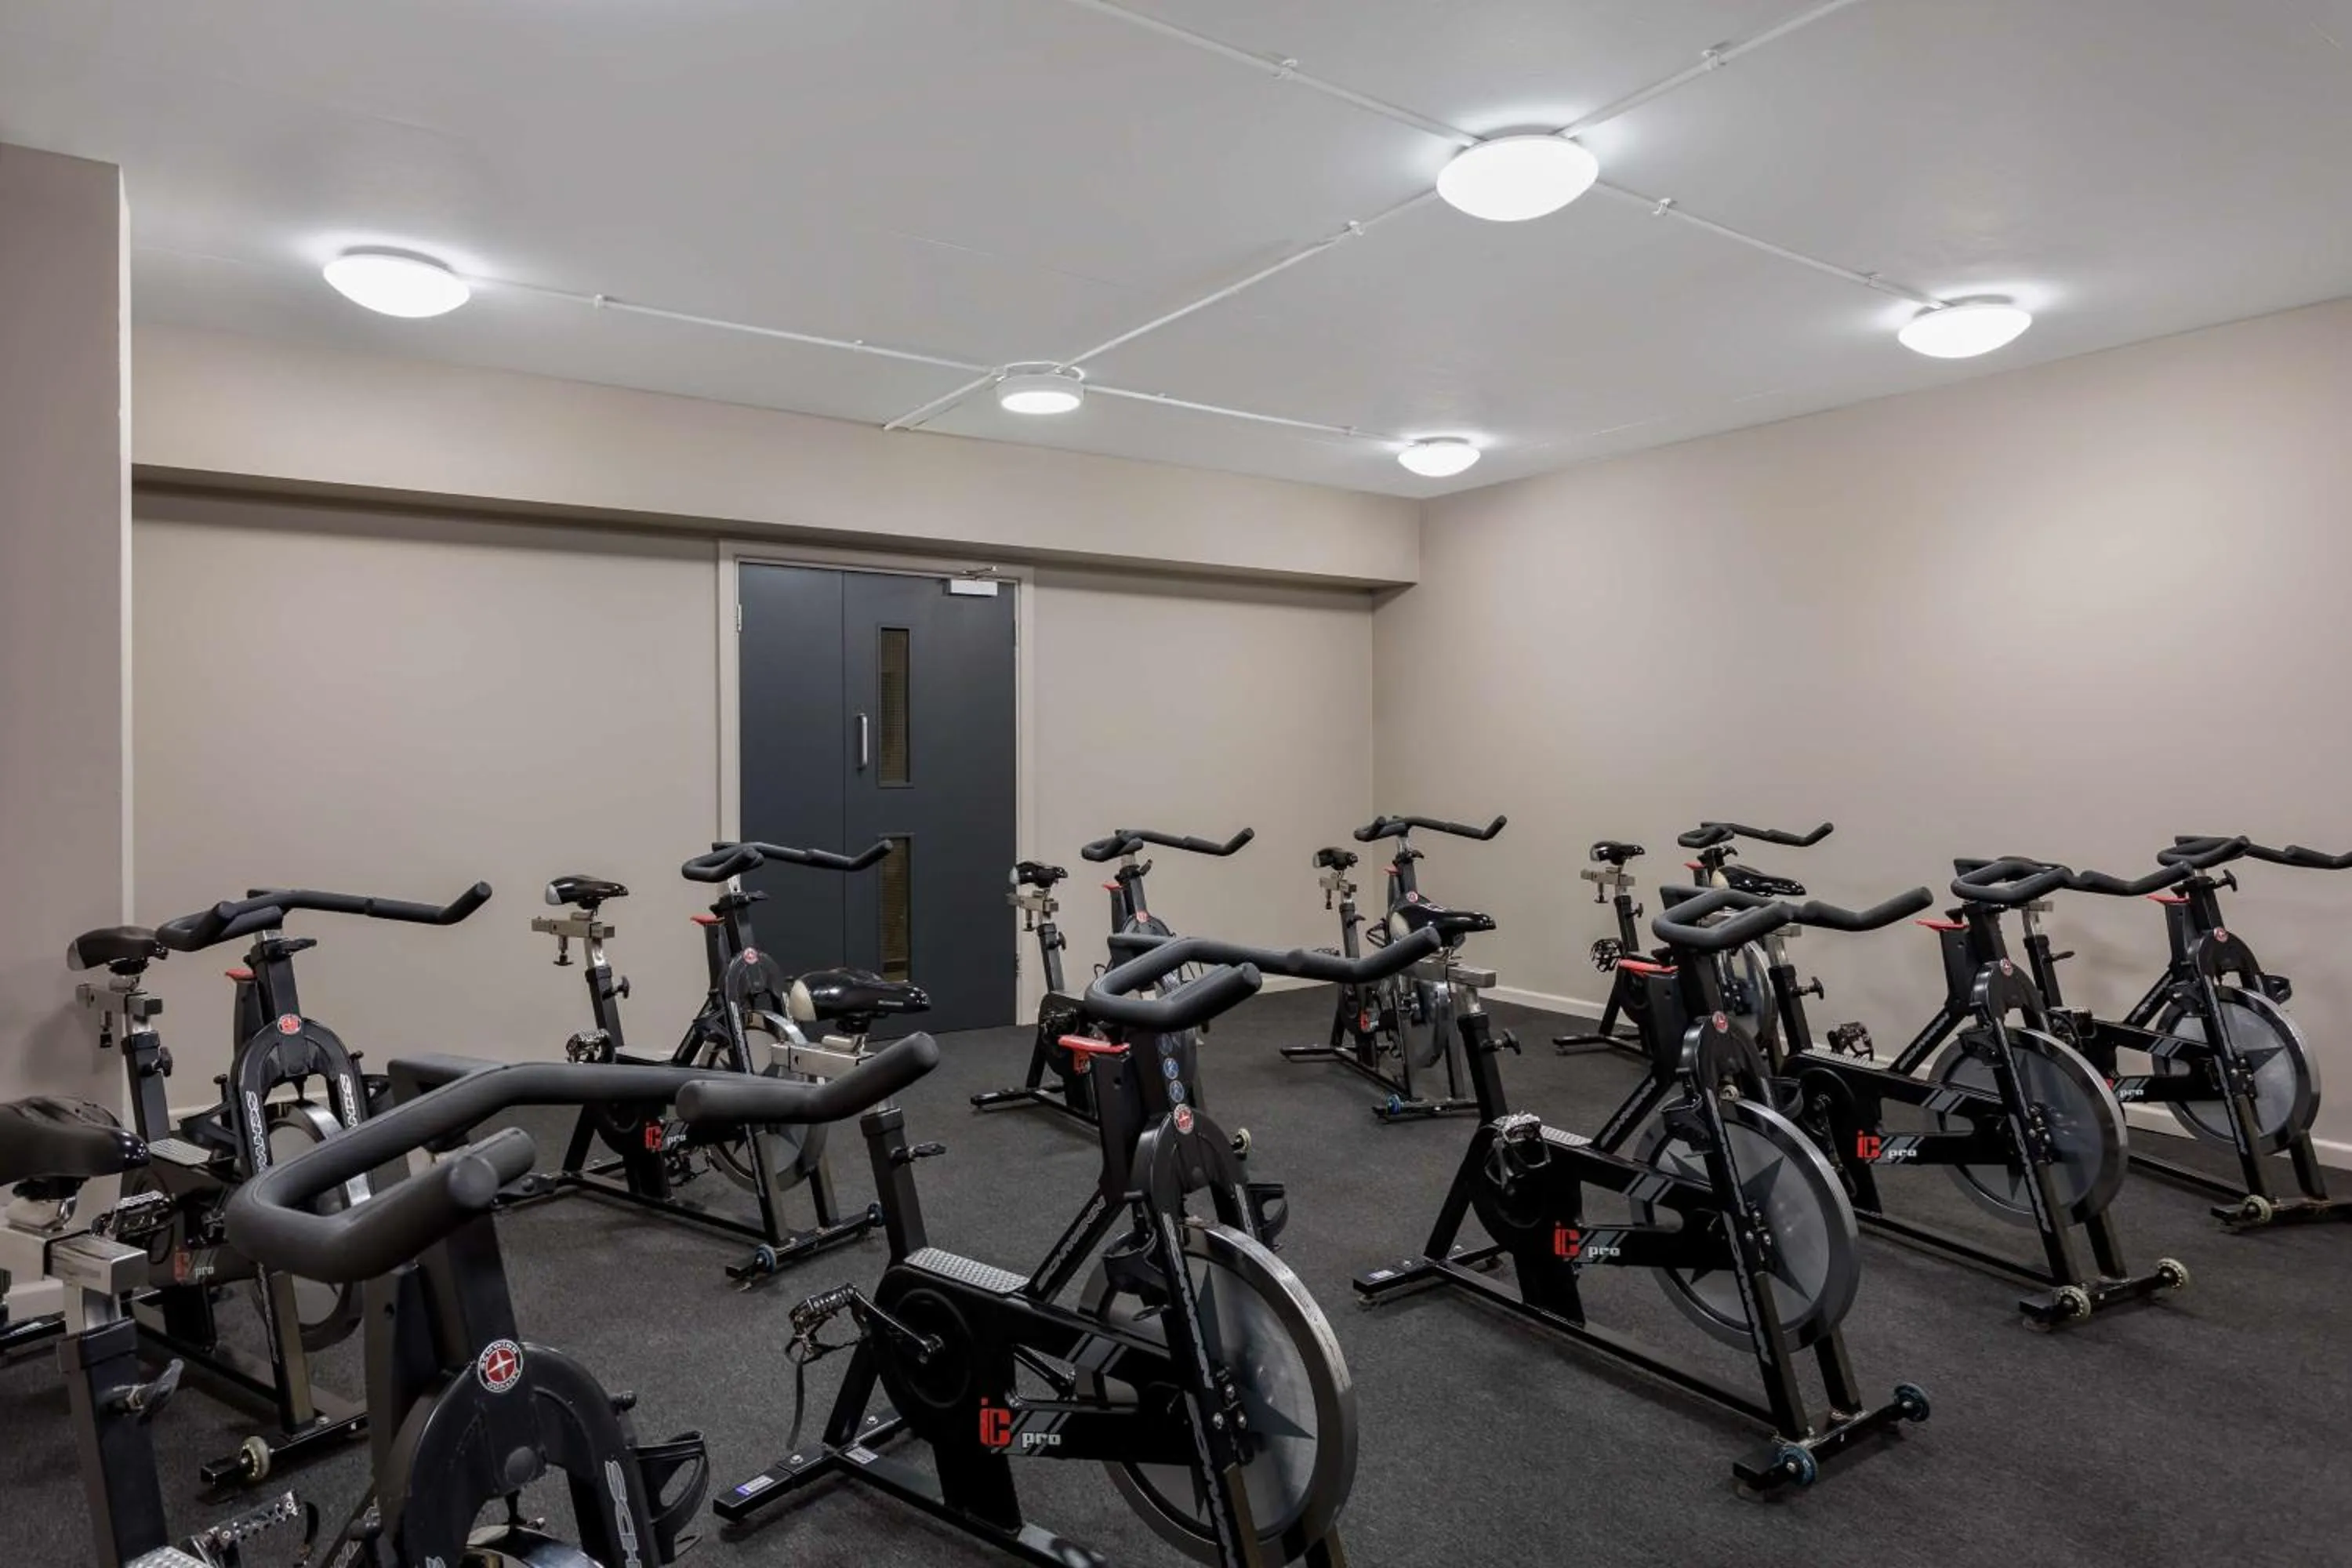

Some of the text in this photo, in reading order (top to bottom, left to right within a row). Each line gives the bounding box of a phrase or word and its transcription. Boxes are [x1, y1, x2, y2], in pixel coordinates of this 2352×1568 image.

[1887, 1149, 1918, 1160] pro
[1588, 1246, 1621, 1258] pro
[1022, 1432, 1062, 1449] pro
